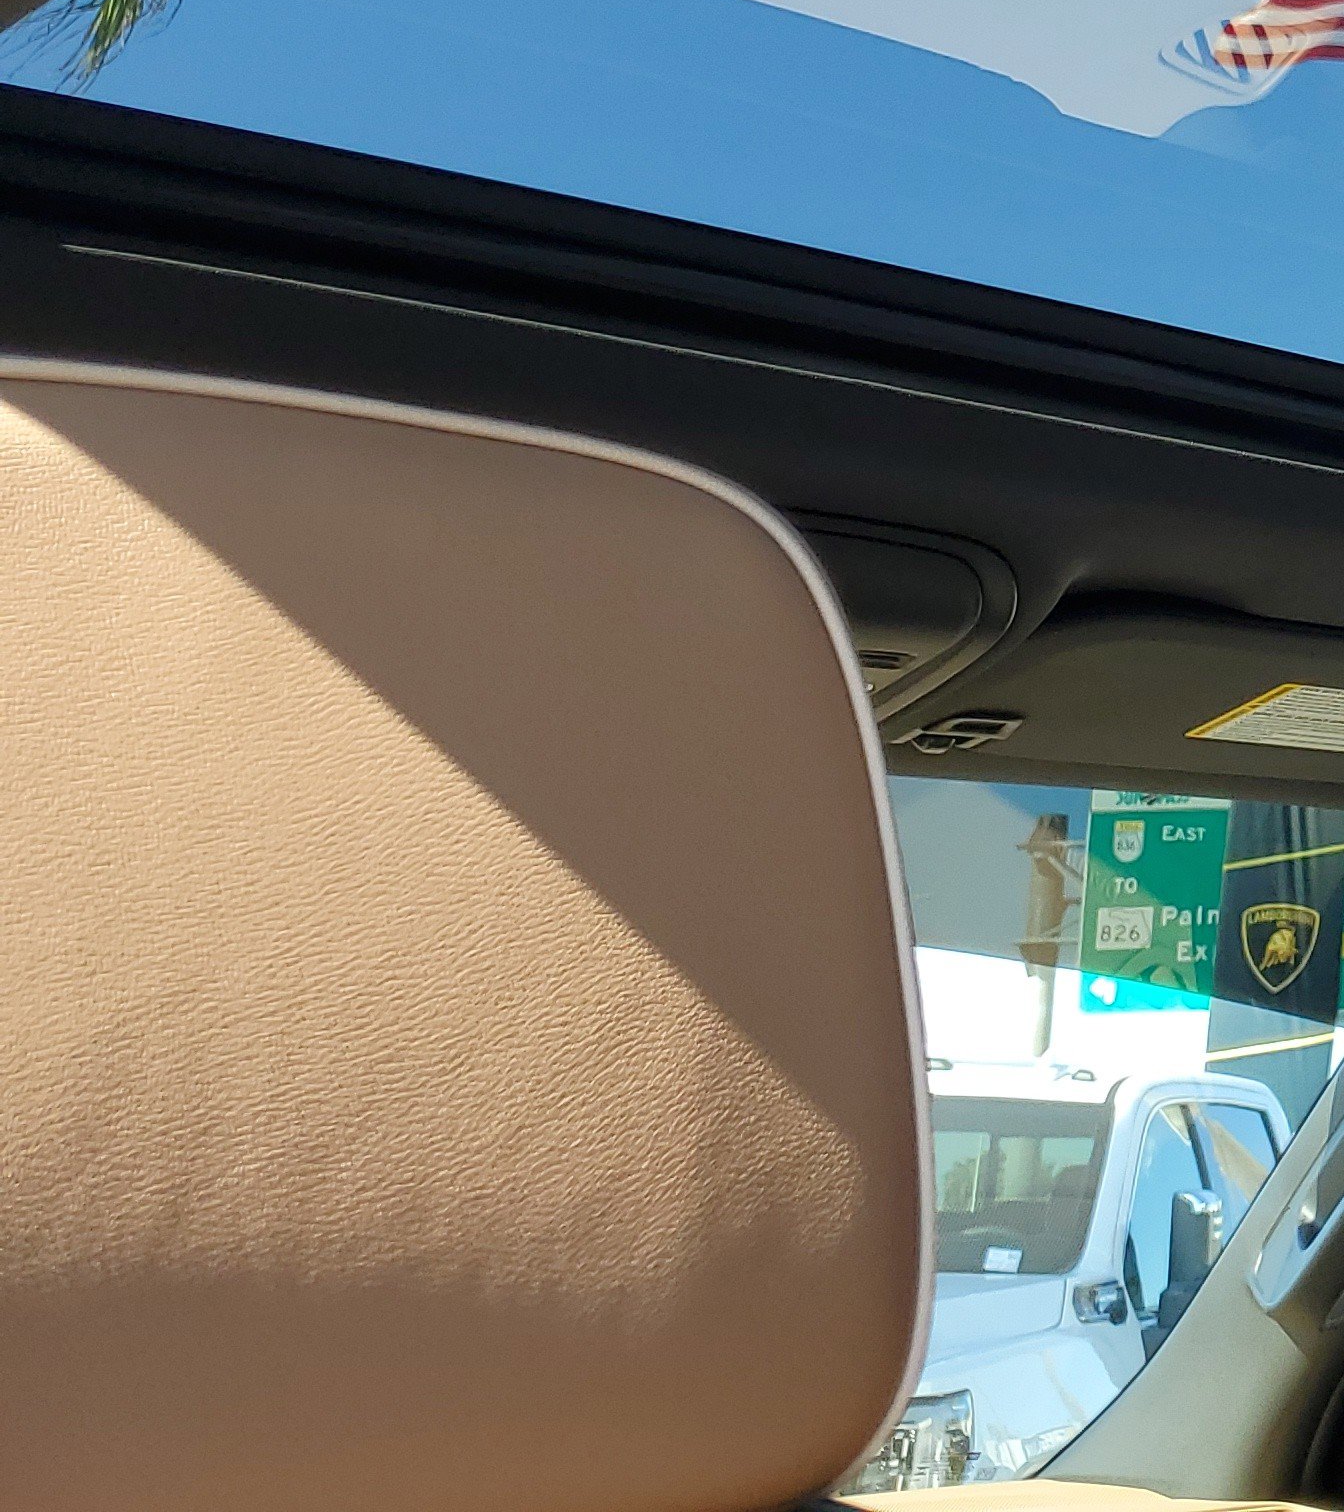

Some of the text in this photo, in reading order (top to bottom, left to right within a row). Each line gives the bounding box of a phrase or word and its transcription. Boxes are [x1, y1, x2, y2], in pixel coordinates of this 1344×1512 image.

[1162, 825, 1206, 841] EAST
[1115, 877, 1138, 894] TO
[1100, 925, 1140, 942] 826
